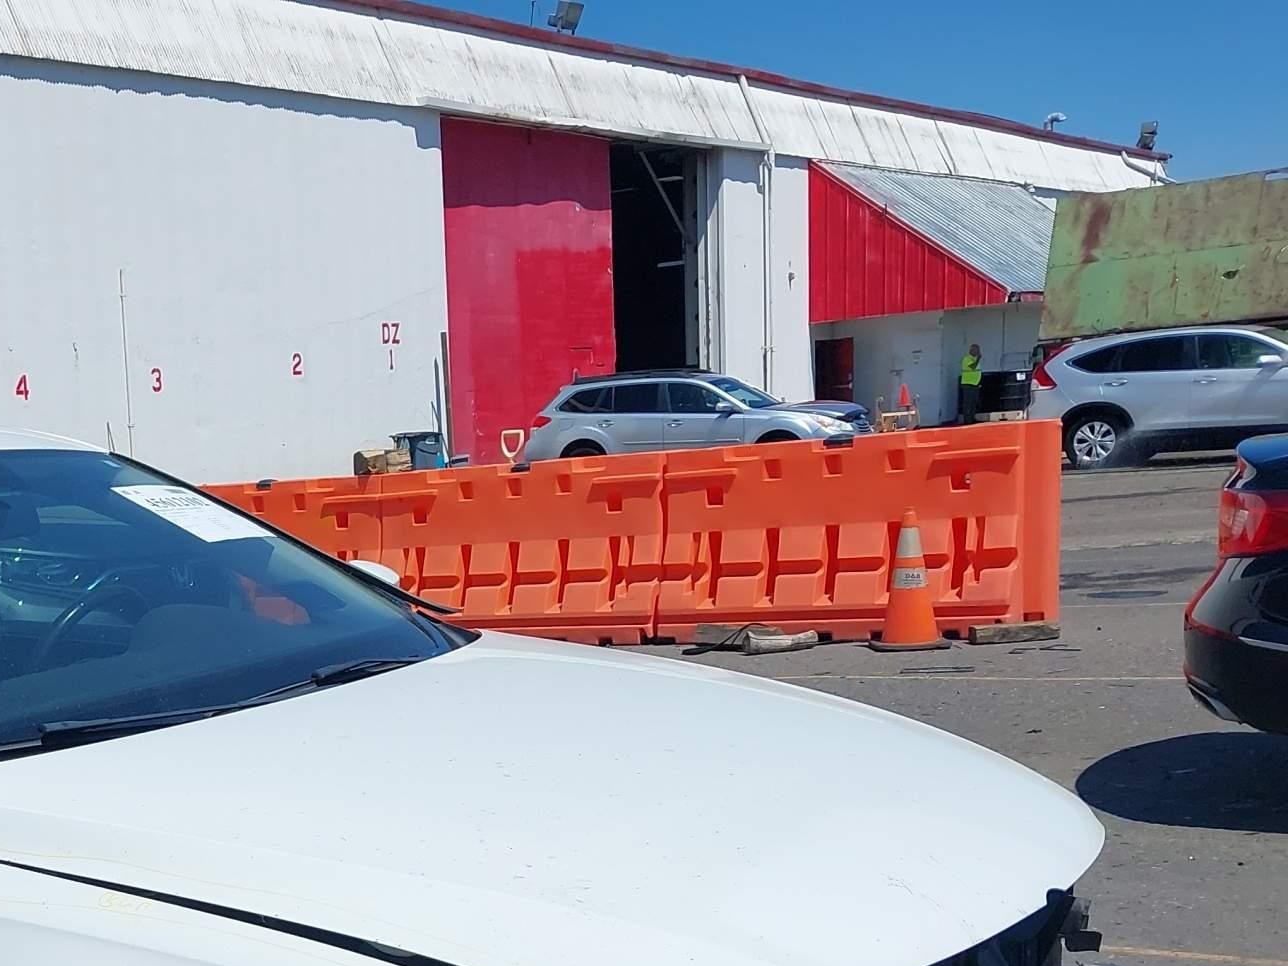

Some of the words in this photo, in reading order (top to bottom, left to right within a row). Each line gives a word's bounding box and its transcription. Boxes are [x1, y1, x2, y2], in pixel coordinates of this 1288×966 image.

[382, 322, 400, 344] DZ
[292, 352, 303, 376] 2
[389, 349, 394, 370] 1
[15, 374, 30, 401] 4
[151, 368, 162, 393] 3
